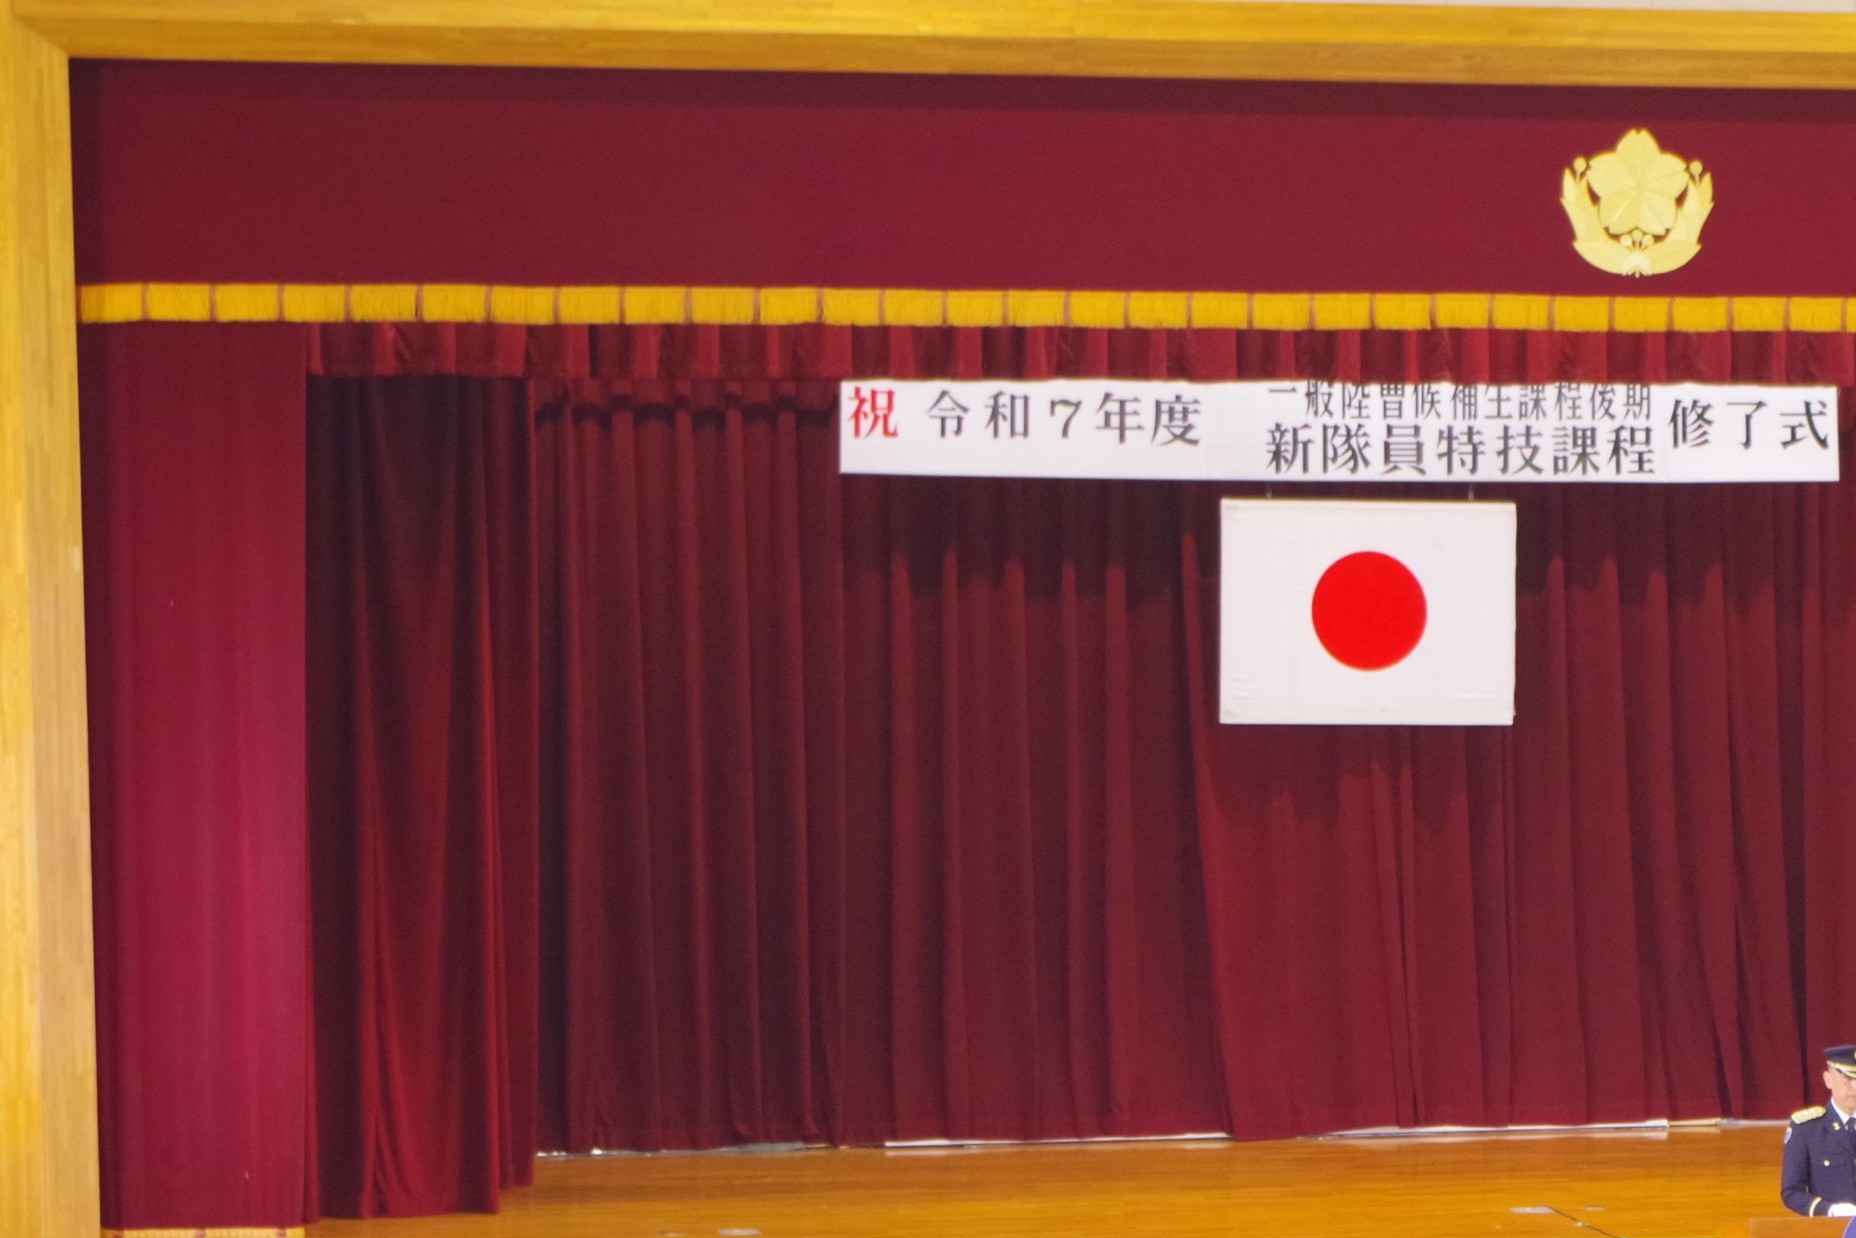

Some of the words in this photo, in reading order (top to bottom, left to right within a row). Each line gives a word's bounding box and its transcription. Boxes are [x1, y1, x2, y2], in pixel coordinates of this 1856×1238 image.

[848, 386, 899, 439] 祝
[926, 389, 1202, 447] 令和7年度
[1668, 399, 1830, 450] 修了式
[1266, 421, 1656, 477] 新隊員特技課程
